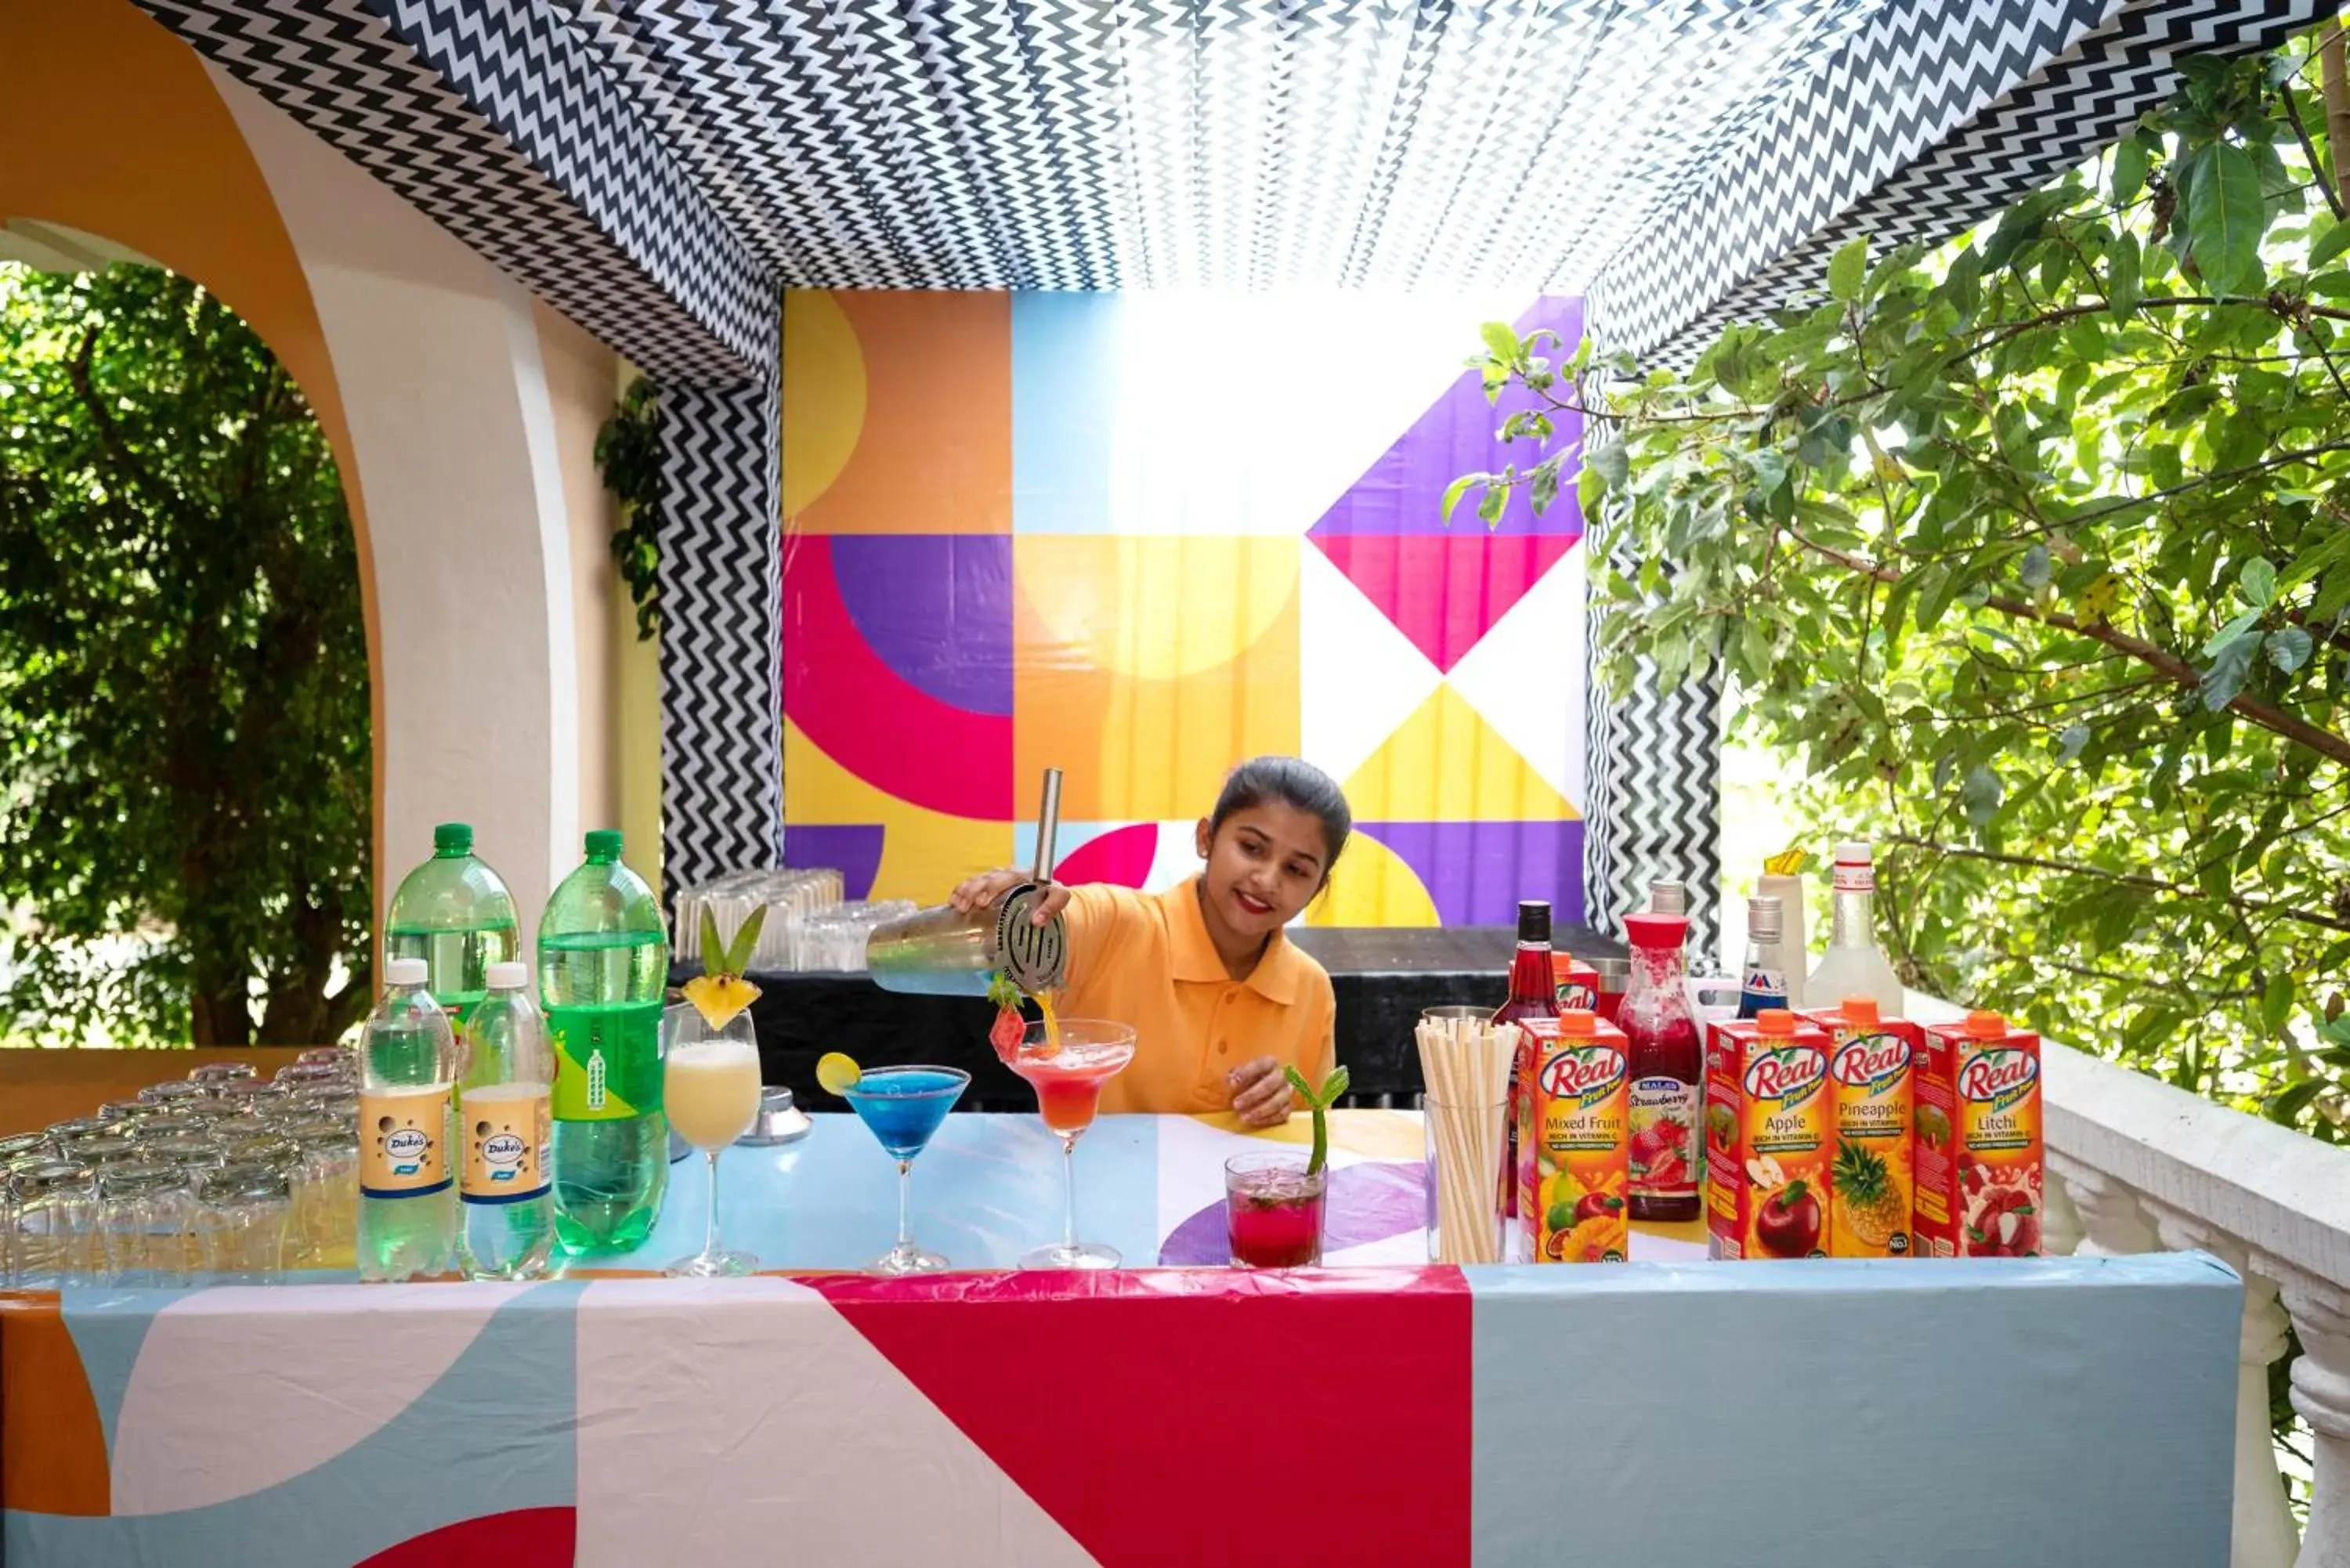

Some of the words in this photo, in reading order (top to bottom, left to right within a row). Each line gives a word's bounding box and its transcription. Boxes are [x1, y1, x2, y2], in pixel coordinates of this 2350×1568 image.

[1842, 1039, 1904, 1088] Real
[1550, 1051, 1617, 1100] Real
[1754, 1050, 1817, 1103] Real
[1967, 1051, 2029, 1105] Real
[1838, 1102, 1907, 1118] Pineapple
[1546, 1116, 1585, 1130] Mixed
[1589, 1116, 1621, 1130] Fruit
[1765, 1115, 1806, 1133] Apple
[1978, 1115, 2017, 1130] Litchi
[391, 1136, 424, 1148] Duke's
[488, 1140, 521, 1153] Duke's
